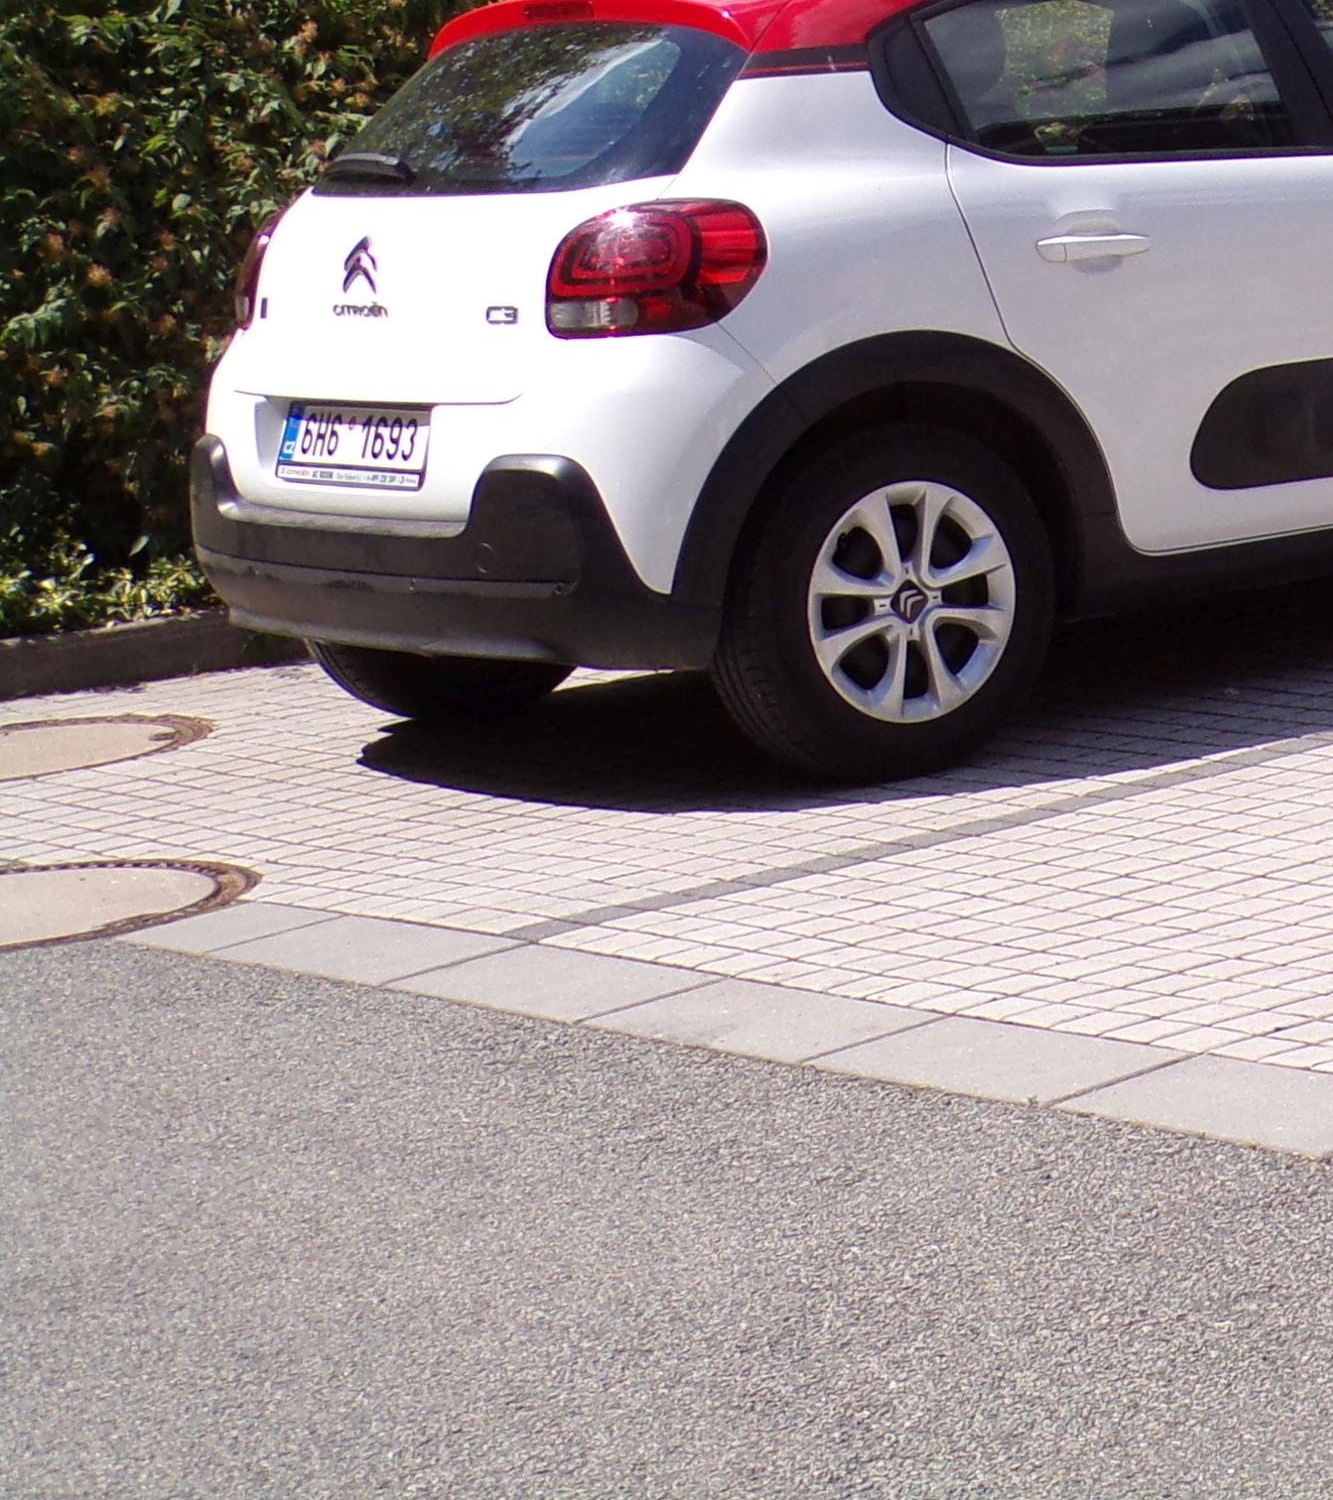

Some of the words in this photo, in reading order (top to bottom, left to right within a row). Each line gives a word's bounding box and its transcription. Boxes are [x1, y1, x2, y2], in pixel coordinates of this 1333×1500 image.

[485, 305, 519, 325] C3
[300, 412, 343, 457] 6H6
[361, 414, 418, 462] 1693
